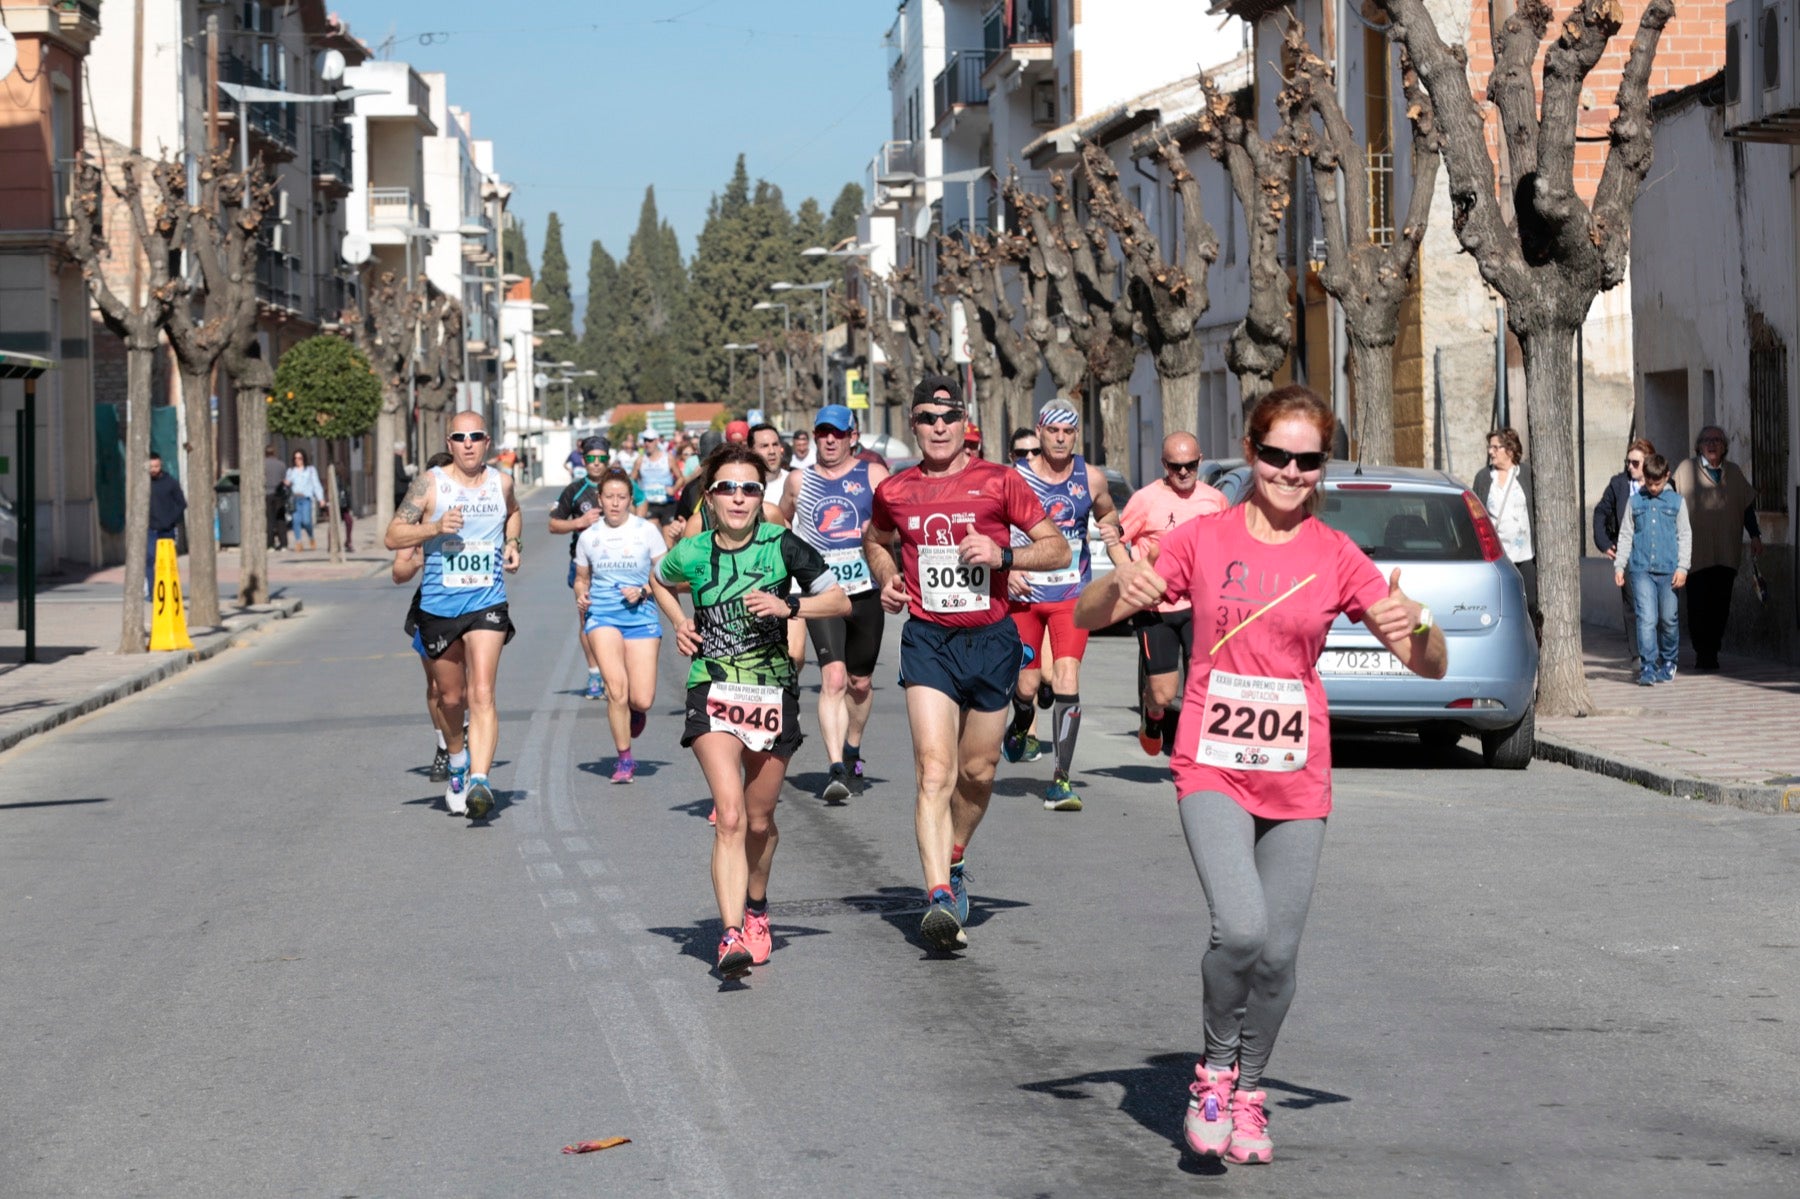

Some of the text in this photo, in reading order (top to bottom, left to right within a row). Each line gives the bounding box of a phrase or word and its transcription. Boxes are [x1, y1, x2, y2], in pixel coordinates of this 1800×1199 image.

[448, 503, 499, 513] MRACENA
[446, 554, 490, 572] 1081
[926, 566, 984, 588] 3030
[1335, 651, 1381, 669] 7023
[1233, 678, 1251, 689] GRAN
[1252, 680, 1276, 692] PREMIO
[1276, 682, 1285, 692] DE
[711, 701, 779, 732] 2046
[1207, 702, 1304, 744] 2204
